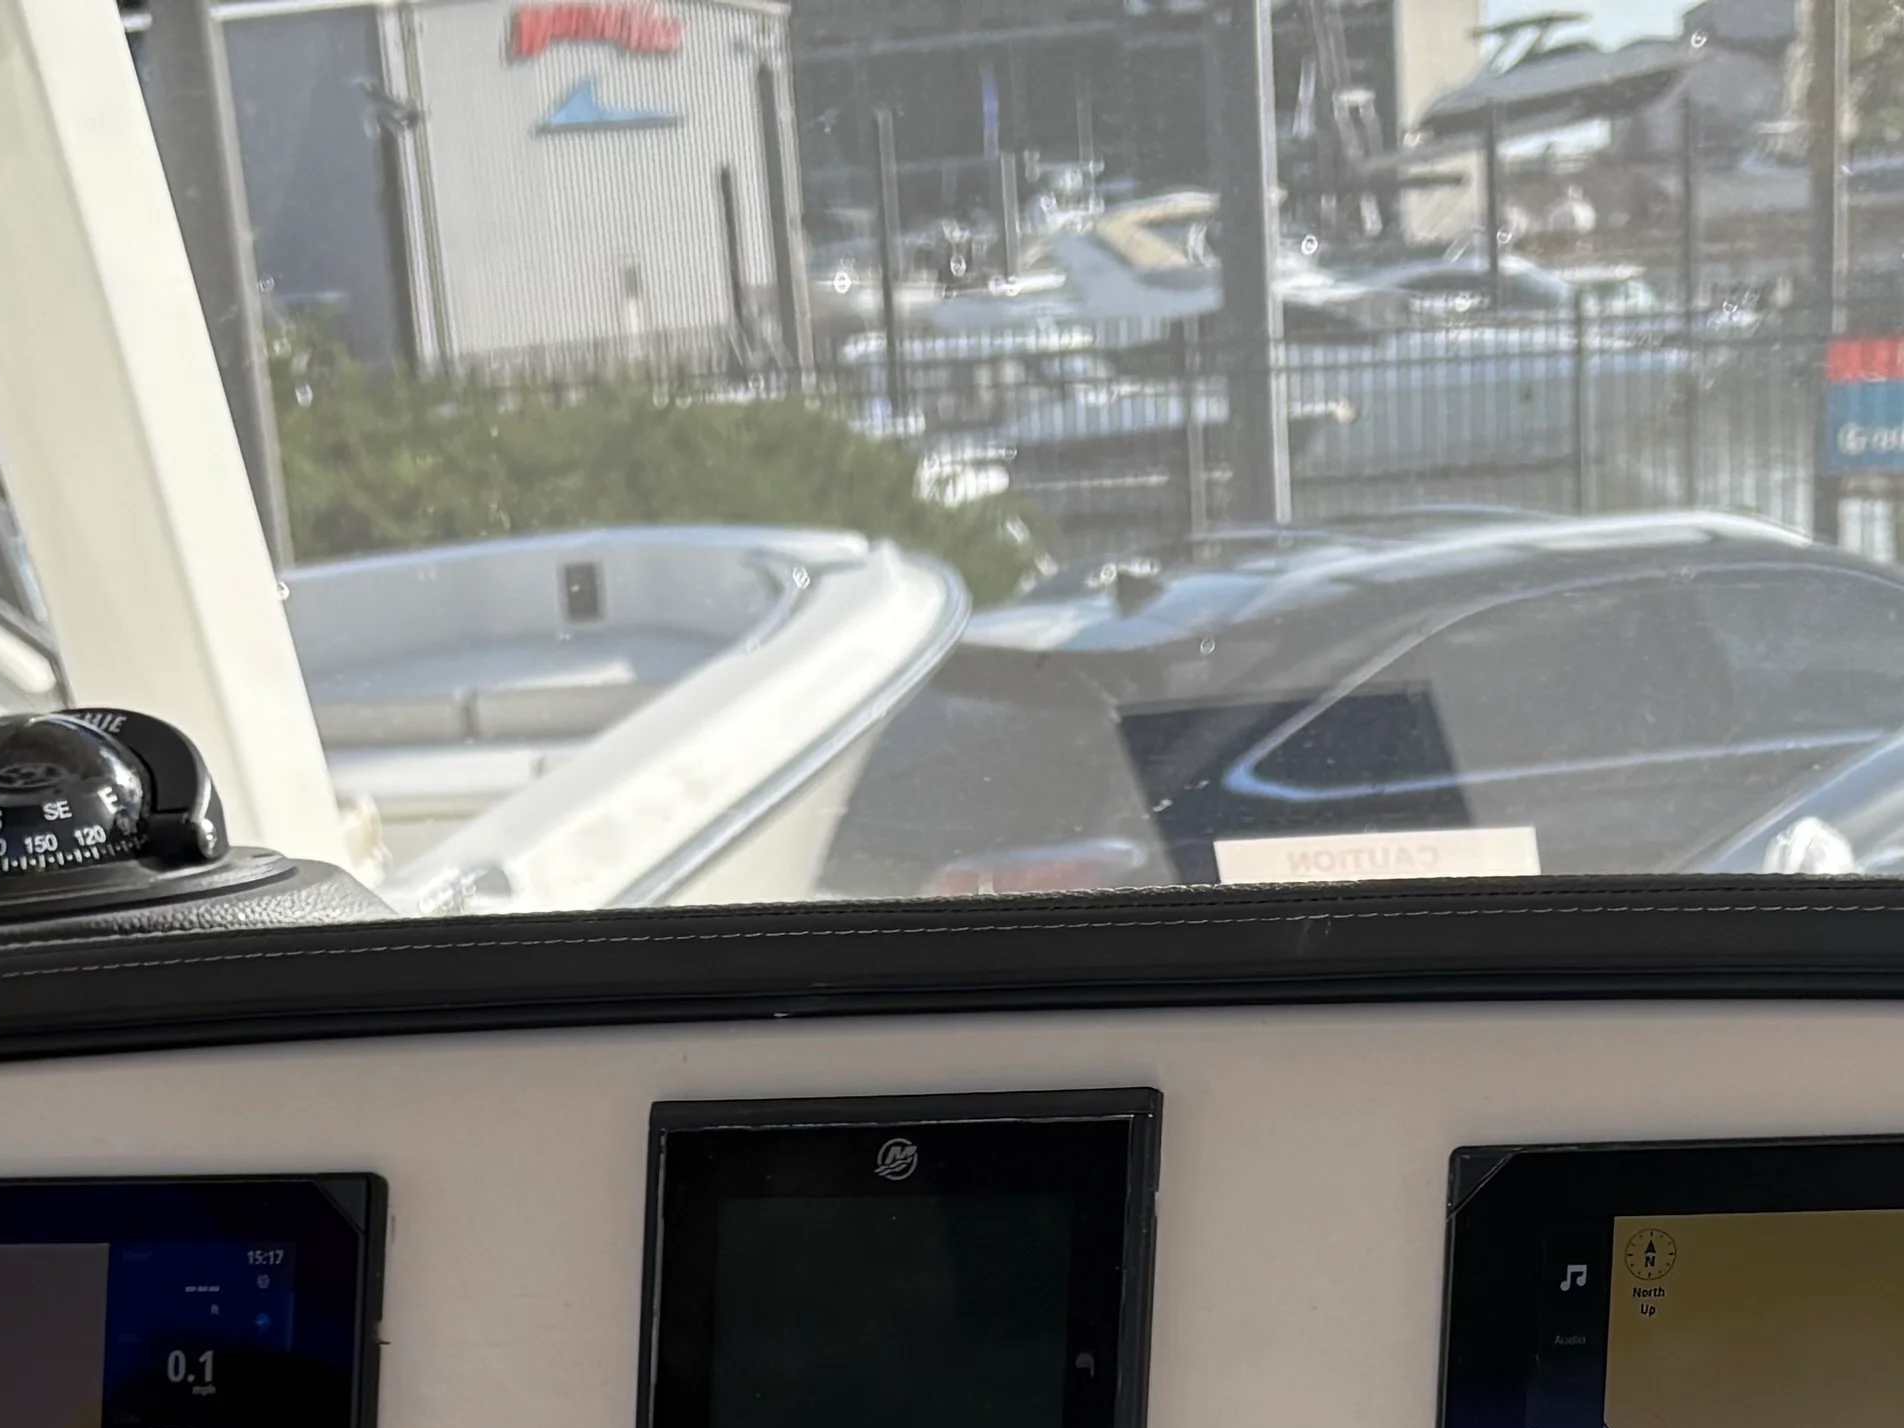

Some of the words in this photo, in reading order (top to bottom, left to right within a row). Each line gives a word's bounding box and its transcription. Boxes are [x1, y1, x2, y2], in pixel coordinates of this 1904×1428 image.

[42, 800, 72, 820] SE
[97, 787, 119, 813] E
[24, 834, 58, 852] 150
[74, 825, 107, 846] 120
[246, 1250, 284, 1266] 15:17
[1644, 1256, 1656, 1267] N
[1632, 1286, 1665, 1298] North
[1640, 1304, 1656, 1317] Up
[166, 1349, 216, 1384] 0.1
